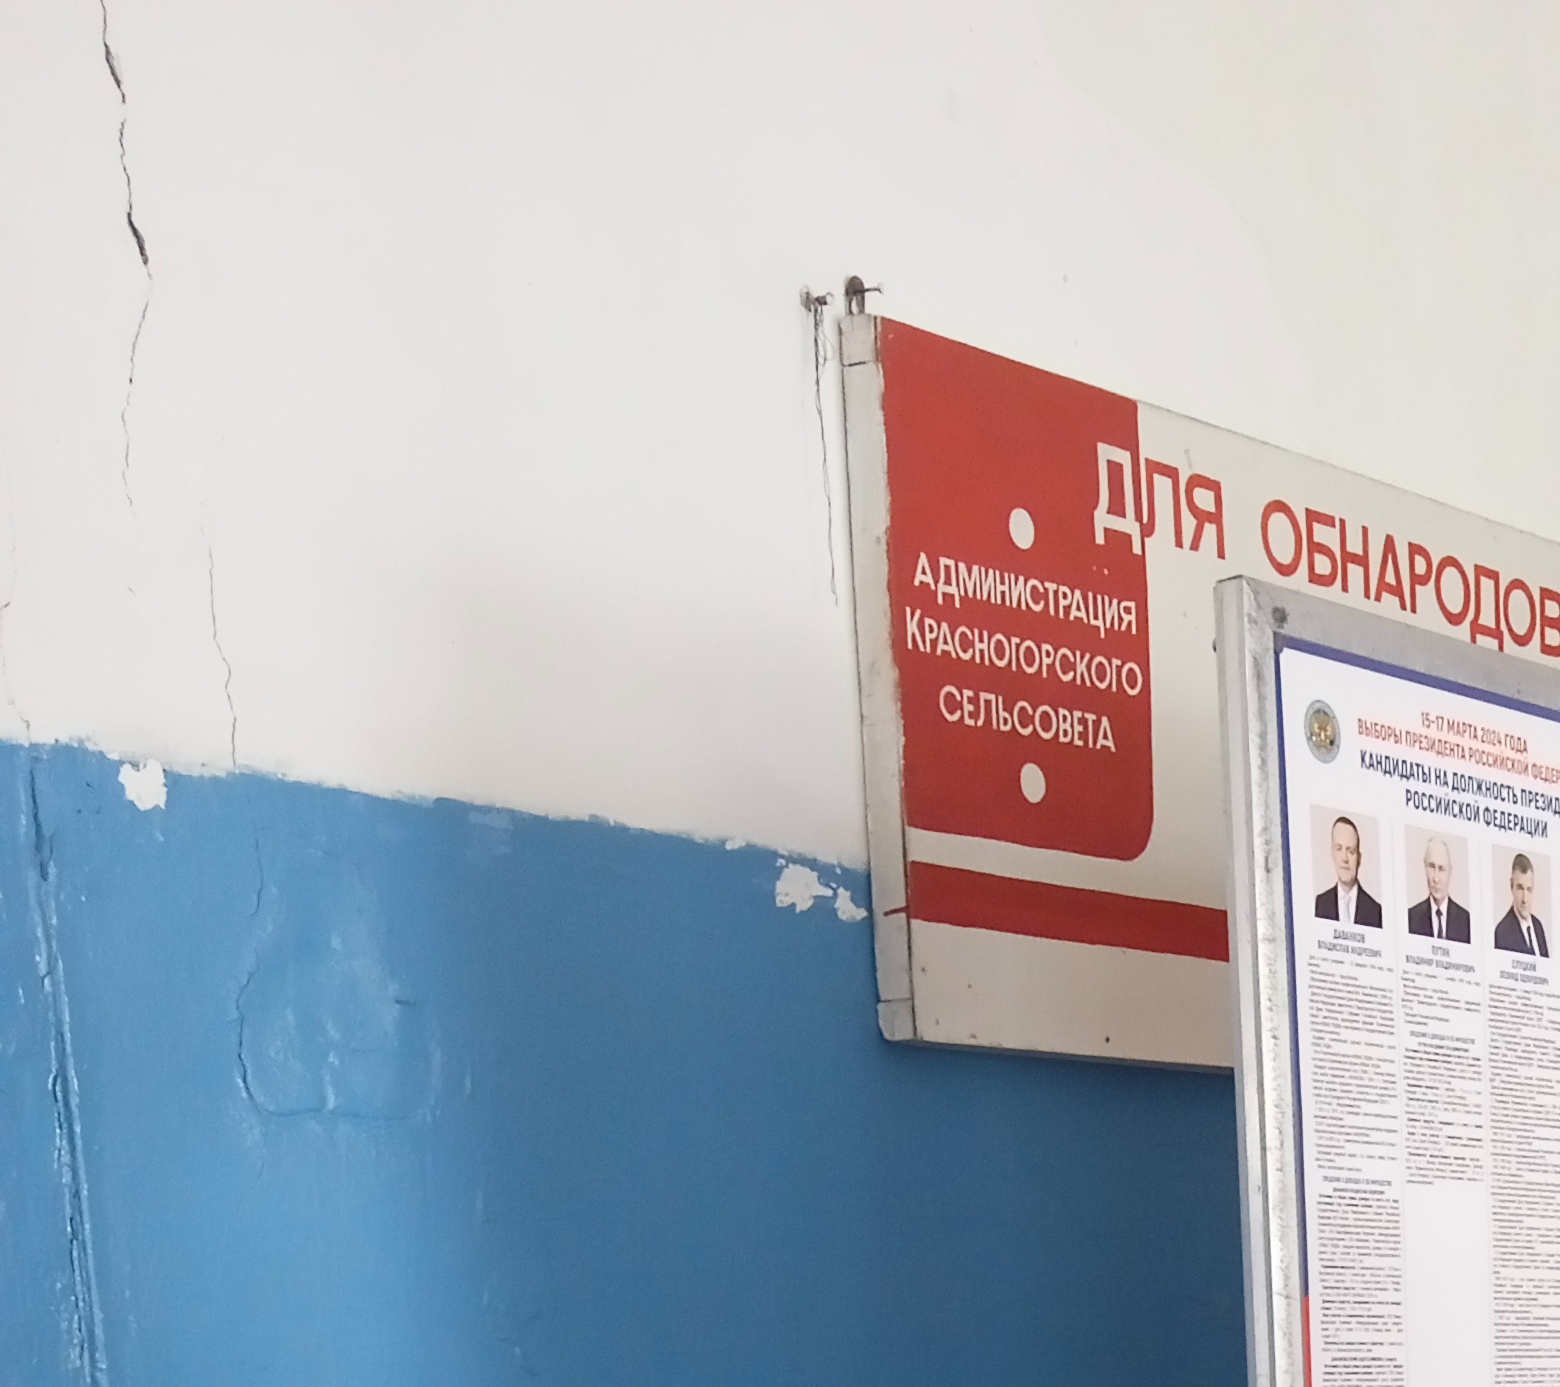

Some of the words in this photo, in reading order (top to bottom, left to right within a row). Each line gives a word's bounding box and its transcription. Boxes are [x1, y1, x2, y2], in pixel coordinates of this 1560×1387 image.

[1092, 441, 1227, 560] ДЛЯ
[913, 551, 1138, 639] АДМИНИСТРАЦИЯ
[905, 605, 1143, 696] КРАСНОГОРСКОГО
[938, 684, 1117, 753] СЕЛЬСОВЕТА
[1357, 717, 1403, 746] ВЫБОРЫ
[1404, 730, 1467, 762] ПРЕЗИДЕНТА
[1468, 745, 1530, 777] РОССИЙСКОЙ
[1446, 718, 1480, 743] МАРТА
[1480, 724, 1503, 748] 2024
[1503, 731, 1529, 755] ГОДА
[1360, 749, 1432, 785] КАНДИДАТЫ
[1433, 769, 1450, 789] НА
[1451, 772, 1519, 804] ДОЛЖНОСТЬ
[1405, 788, 1481, 824] РОССИЙСКОЙ
[1482, 808, 1549, 839] ФЕДЕРАЦИИ
